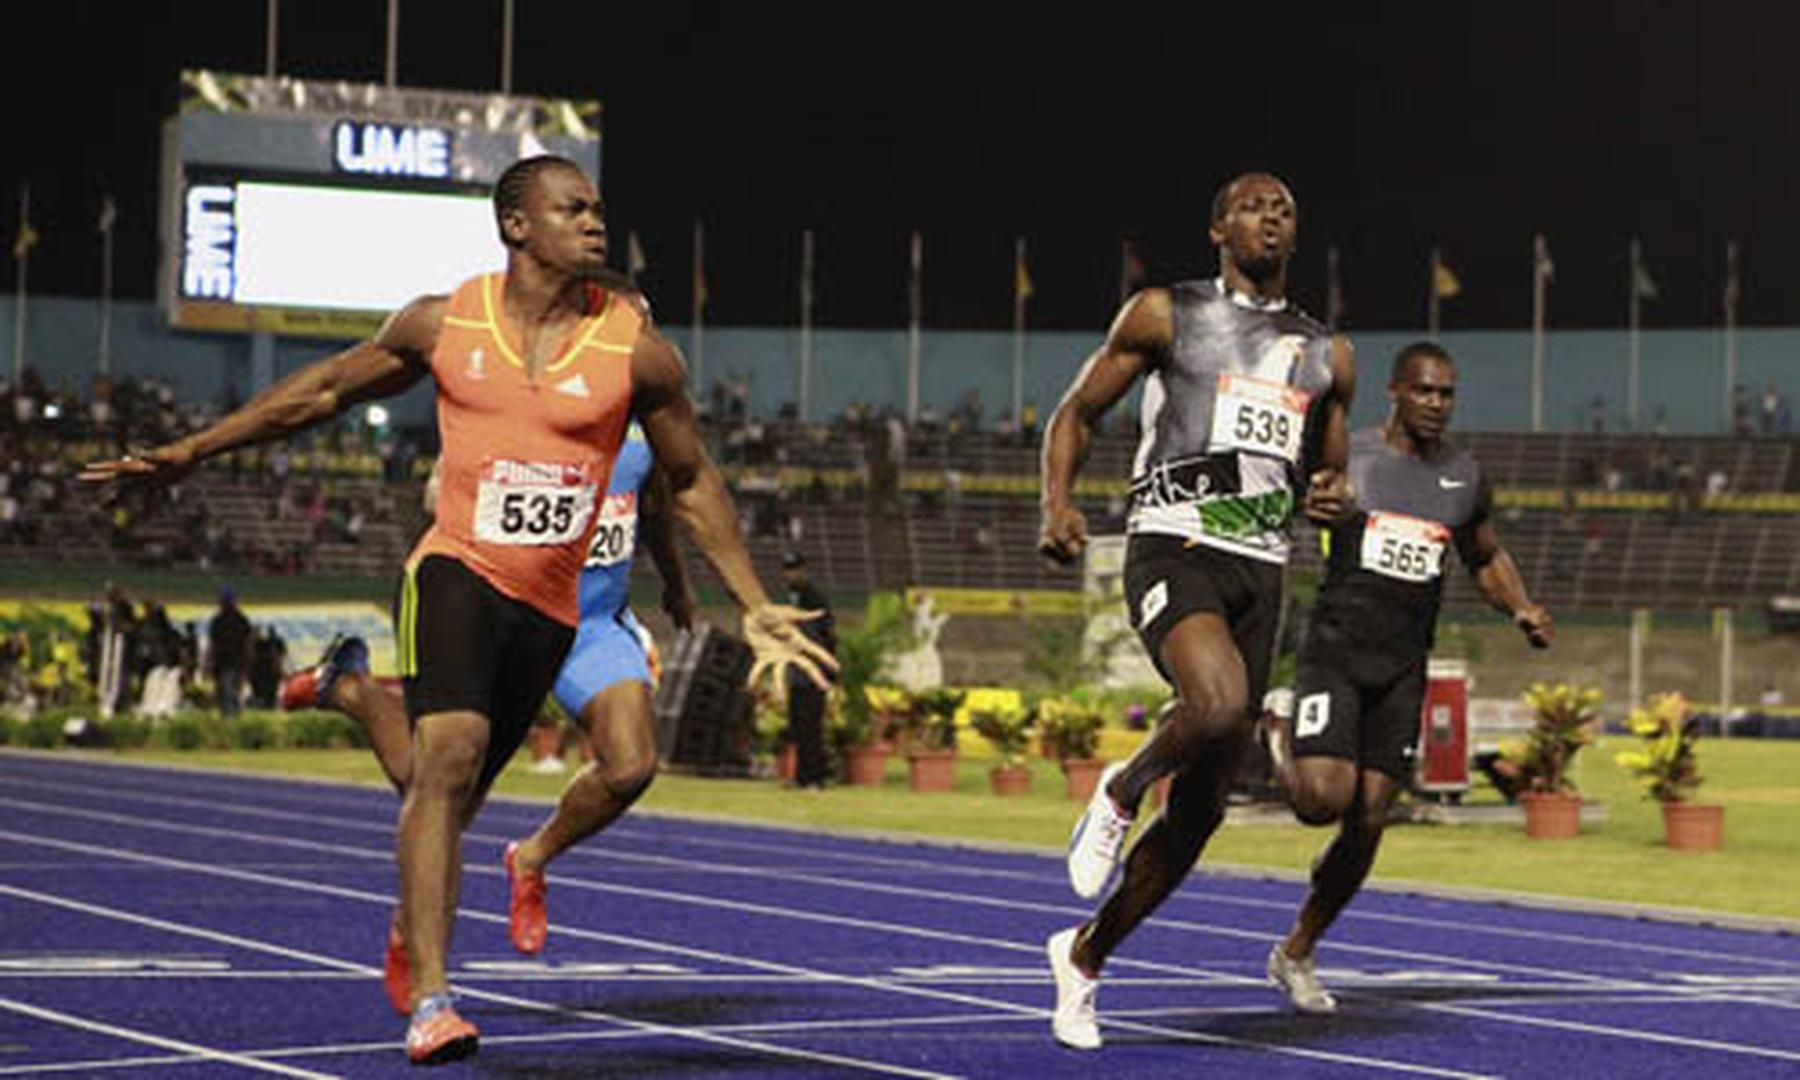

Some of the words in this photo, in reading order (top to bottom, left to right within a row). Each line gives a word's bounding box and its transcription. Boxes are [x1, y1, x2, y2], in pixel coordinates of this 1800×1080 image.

[1233, 403, 1290, 448] 539
[501, 493, 575, 535] 535
[1379, 538, 1430, 576] 565
[1304, 700, 1320, 725] 4
